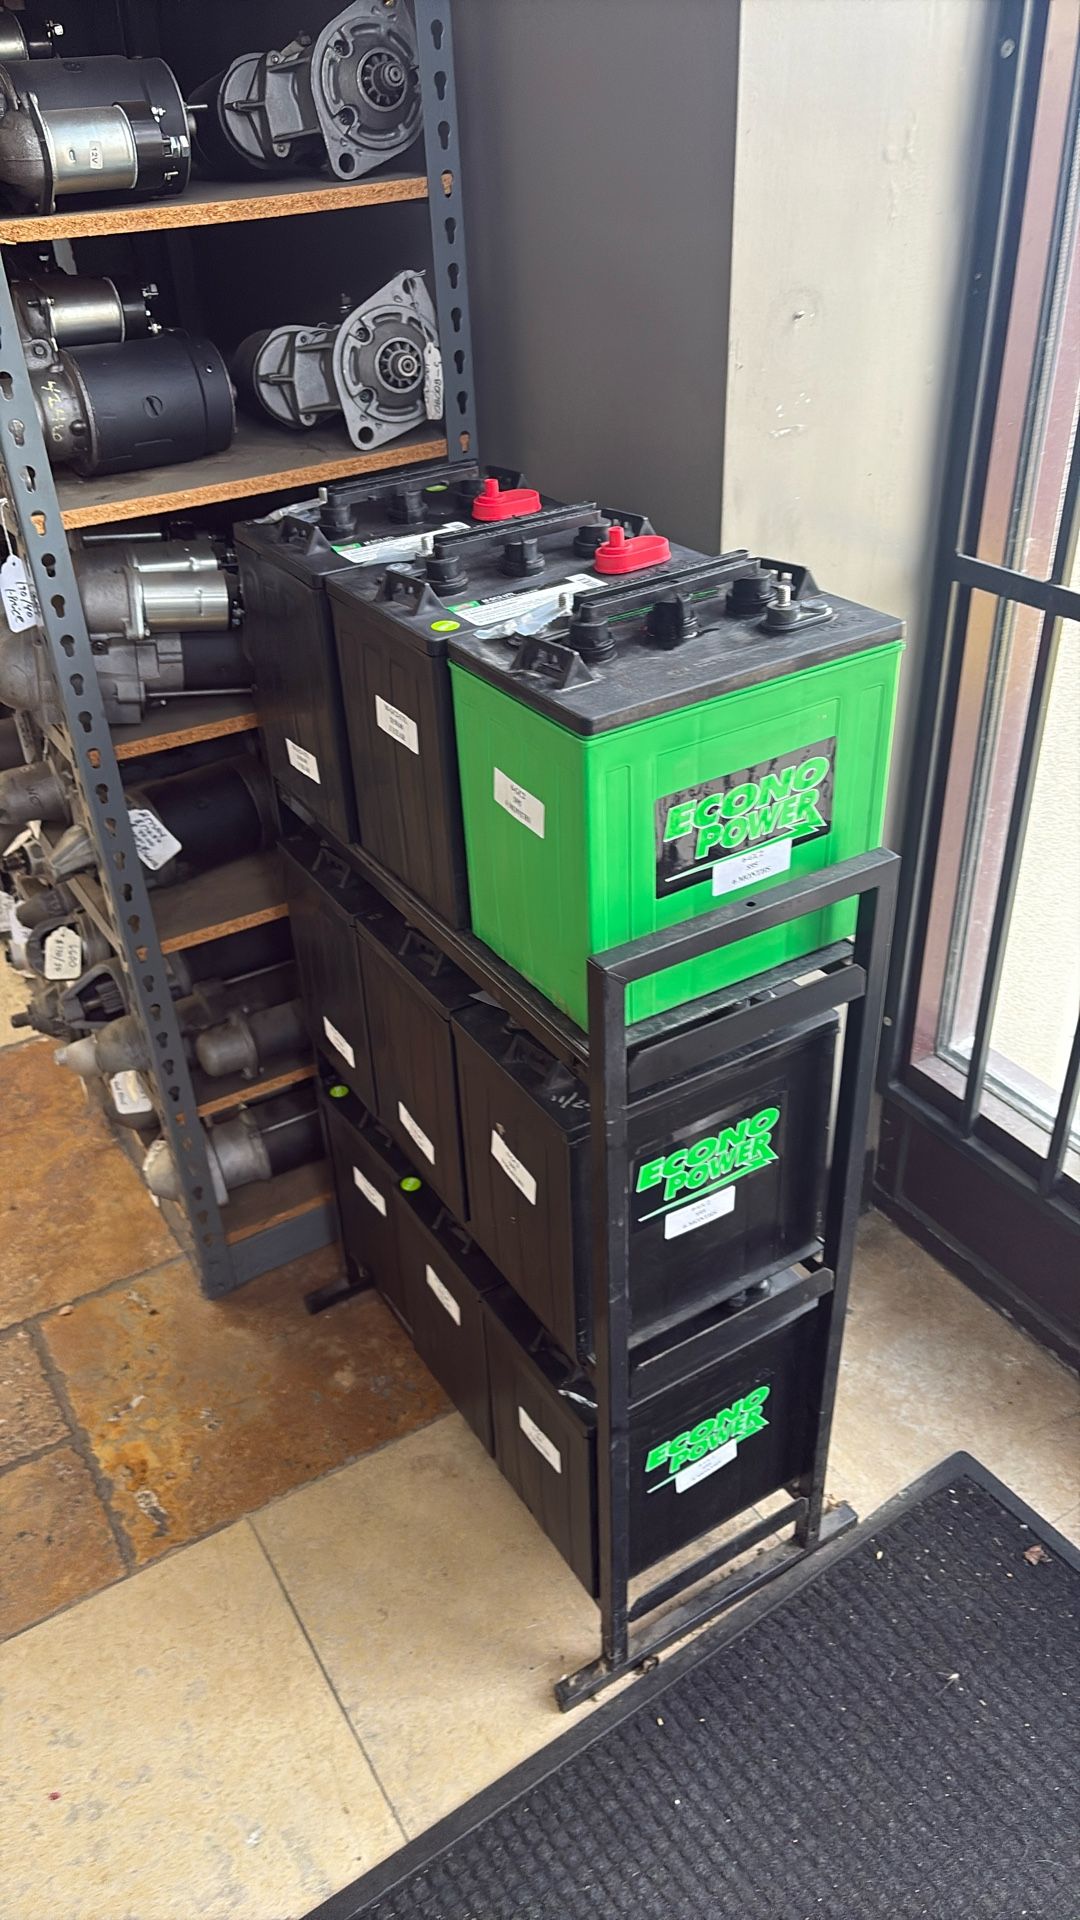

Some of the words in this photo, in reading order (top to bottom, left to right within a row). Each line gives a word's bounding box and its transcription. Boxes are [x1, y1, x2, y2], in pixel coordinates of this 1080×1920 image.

[90, 147, 98, 164] 12V
[663, 756, 830, 842] ECONO
[695, 789, 827, 859] POWER
[636, 1107, 780, 1193] ECONO
[664, 1132, 779, 1201] POWER
[645, 1386, 770, 1472] ECONO
[669, 1405, 770, 1473] POWER
